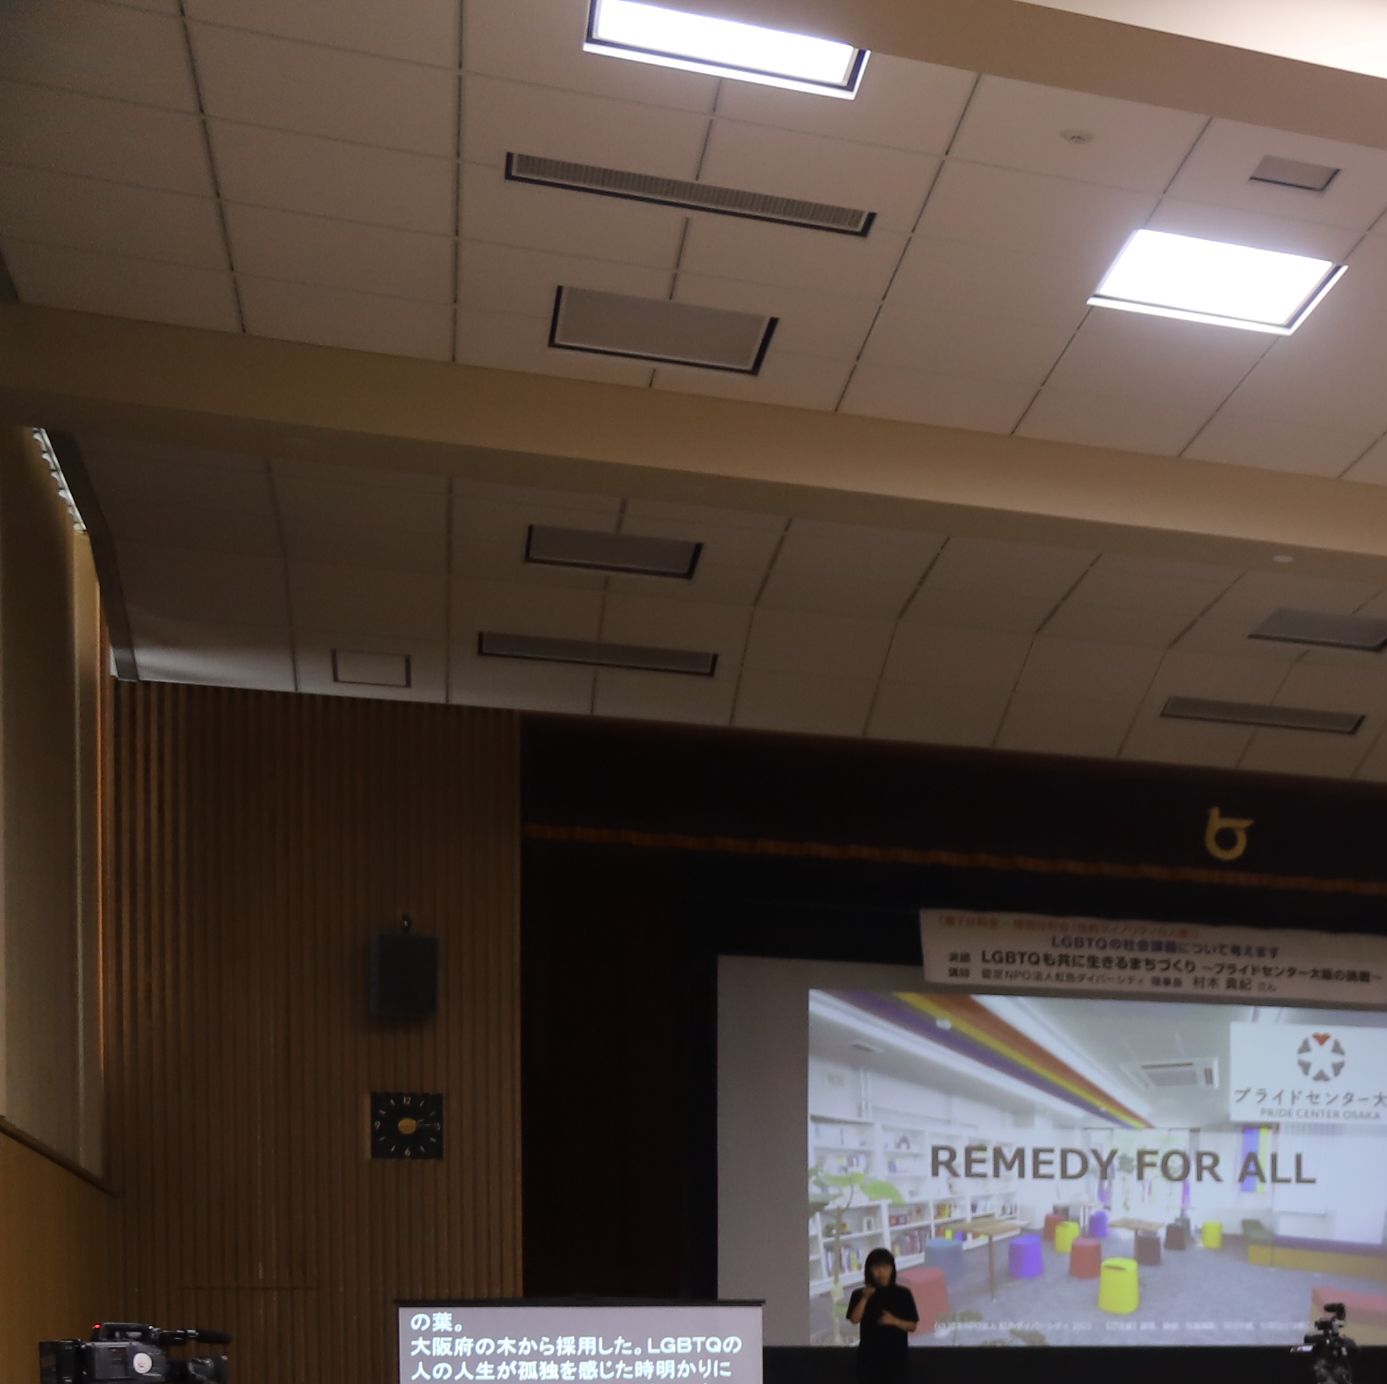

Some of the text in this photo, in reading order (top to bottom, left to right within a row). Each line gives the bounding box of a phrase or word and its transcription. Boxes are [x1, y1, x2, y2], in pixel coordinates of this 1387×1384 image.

[1260, 1107, 1381, 1120] PRIDE CENTER OSAKA
[931, 1145, 1316, 1184] REMEDY FOR ALL
[410, 1312, 463, 1332] の葉。
[410, 1335, 743, 1357] 大阪府の木から採用した。LGBTQの
[411, 1359, 732, 1381] 人の人生が孤独を感じた時明かりに
